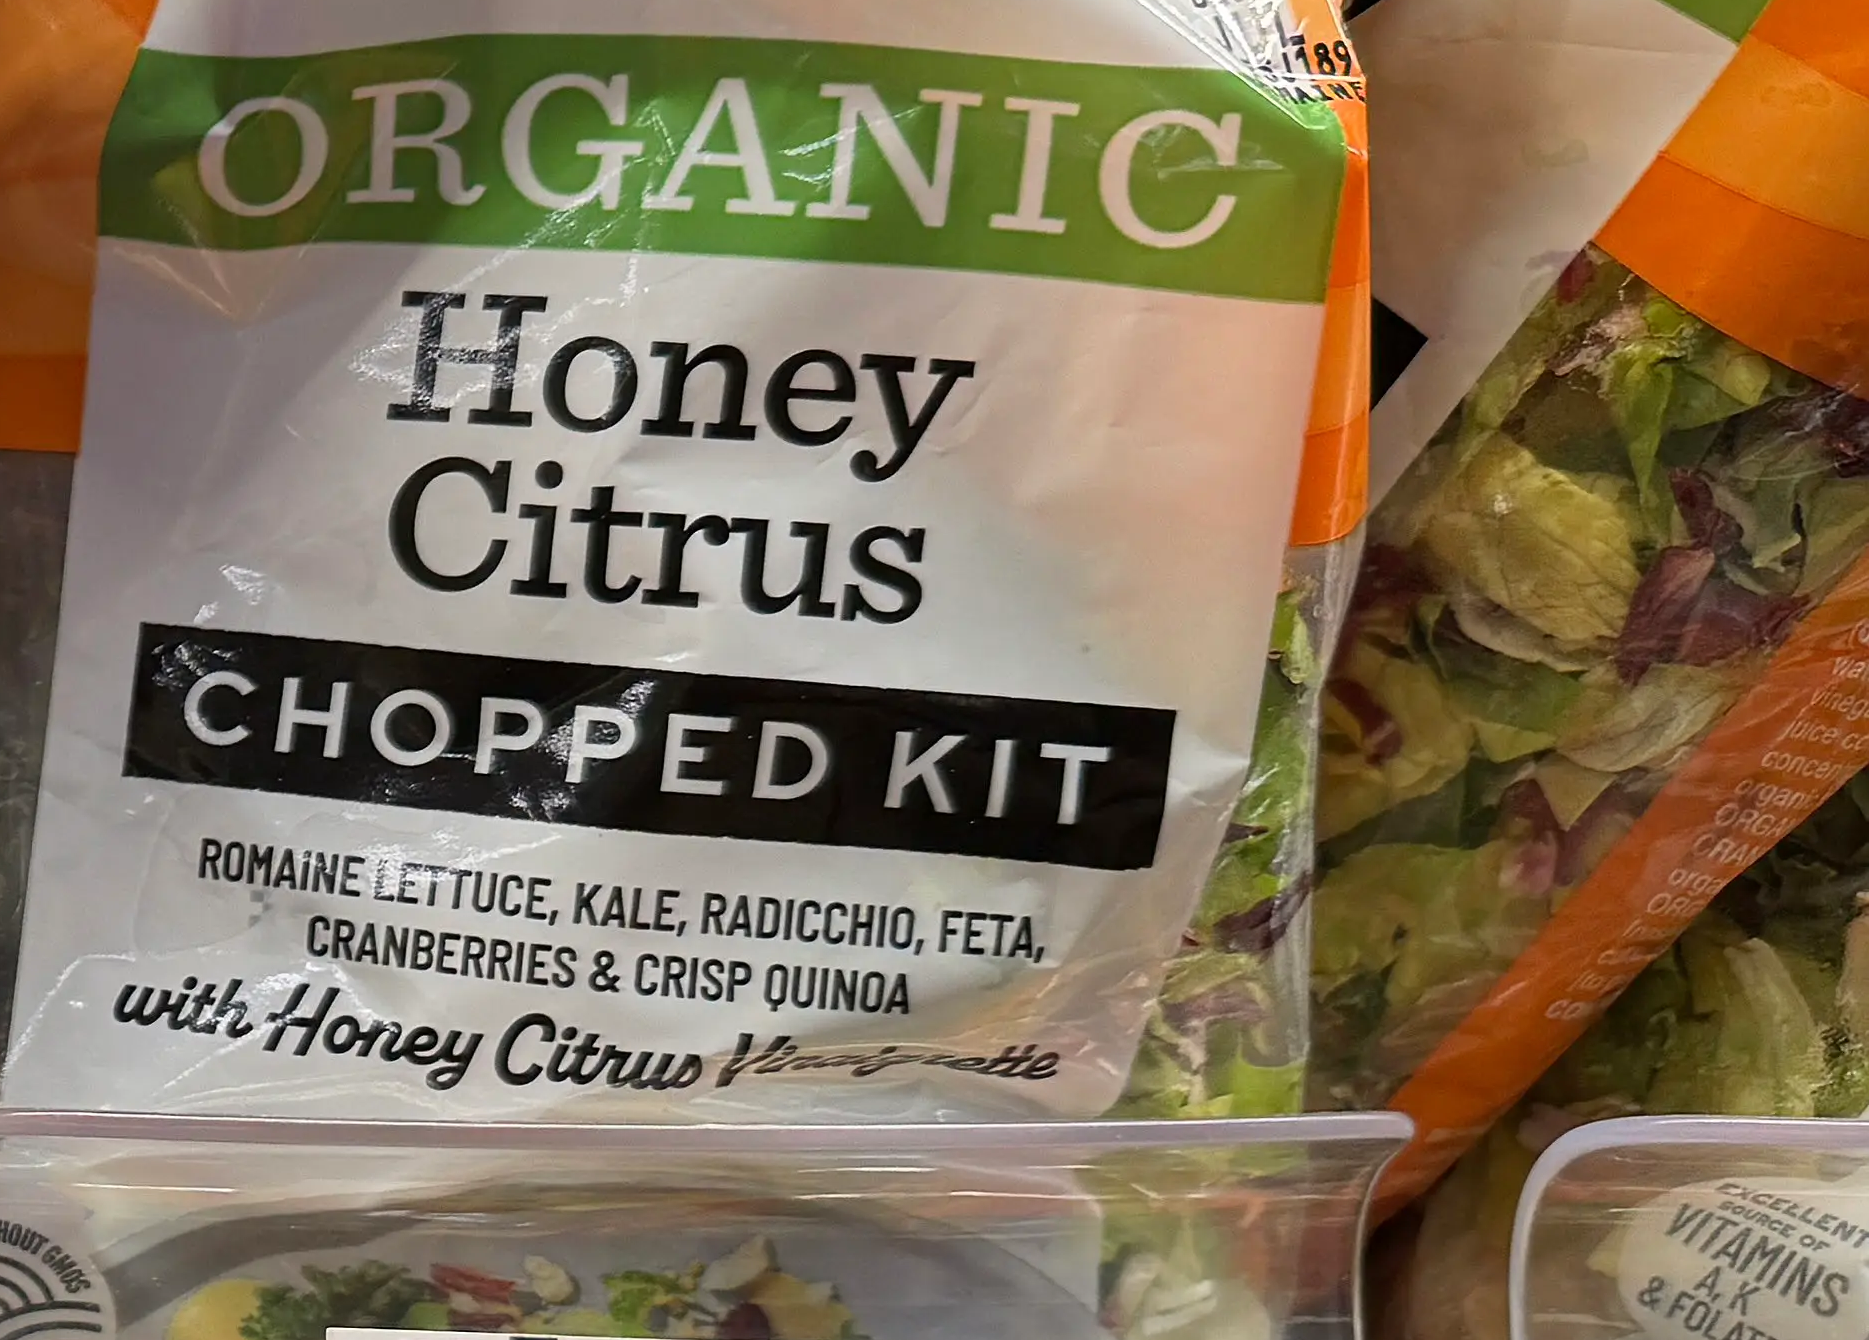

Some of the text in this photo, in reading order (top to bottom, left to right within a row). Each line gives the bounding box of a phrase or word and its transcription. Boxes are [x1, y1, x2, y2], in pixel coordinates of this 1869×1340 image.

[197, 72, 1245, 253] ORGANIC
[385, 289, 975, 482] Honey
[387, 455, 928, 625] Citrus
[180, 667, 1112, 827] CHOPPED KIT
[198, 838, 1046, 965] ROMAINE LETTUCE, KALE, RADICCHIO, FETA,
[305, 912, 913, 1019] CRANBERRIES & CRISP QUINOA
[1637, 1275, 1665, 1311] &
[1664, 1201, 1850, 1319] VITAMINS
